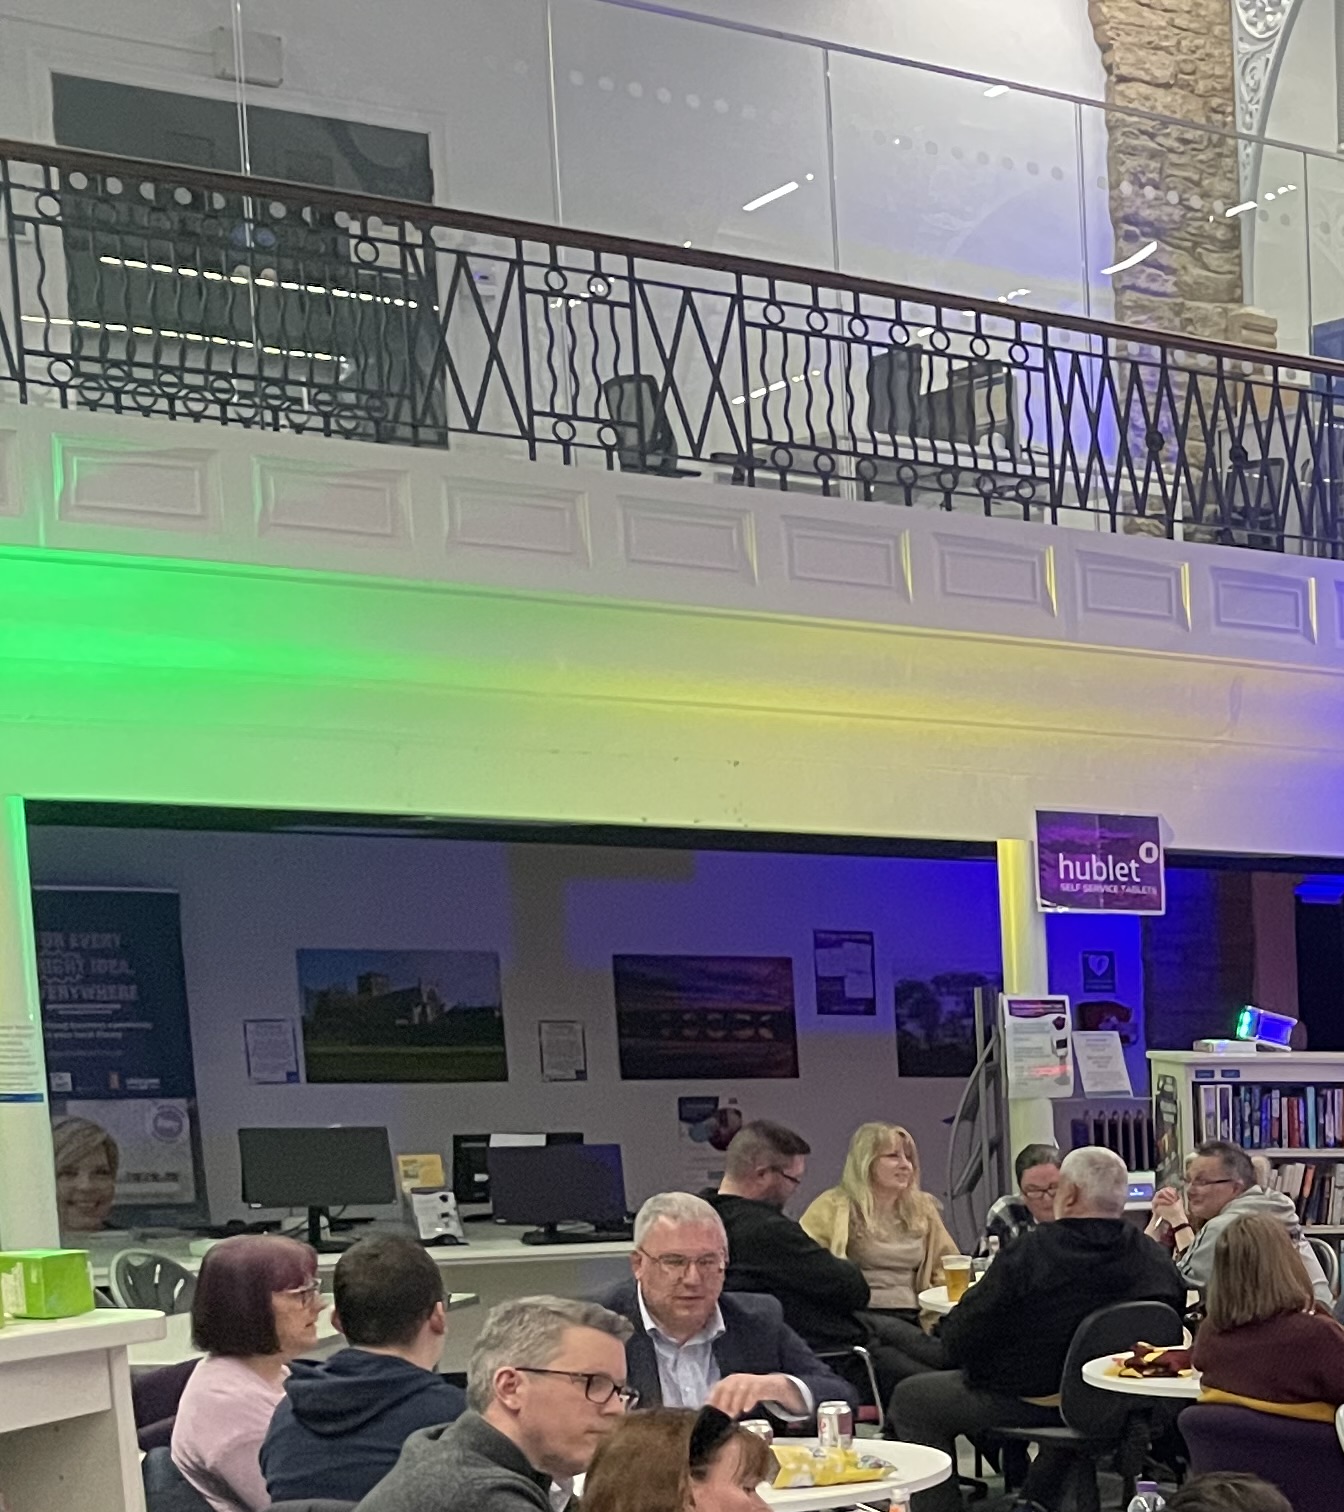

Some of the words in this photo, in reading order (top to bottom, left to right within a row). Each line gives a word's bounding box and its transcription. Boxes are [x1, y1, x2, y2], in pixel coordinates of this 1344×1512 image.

[1059, 852, 1141, 882] hublet
[1060, 882, 1081, 892] SELF
[1082, 883, 1118, 894] SERVICE
[1120, 884, 1158, 895] TABLETS
